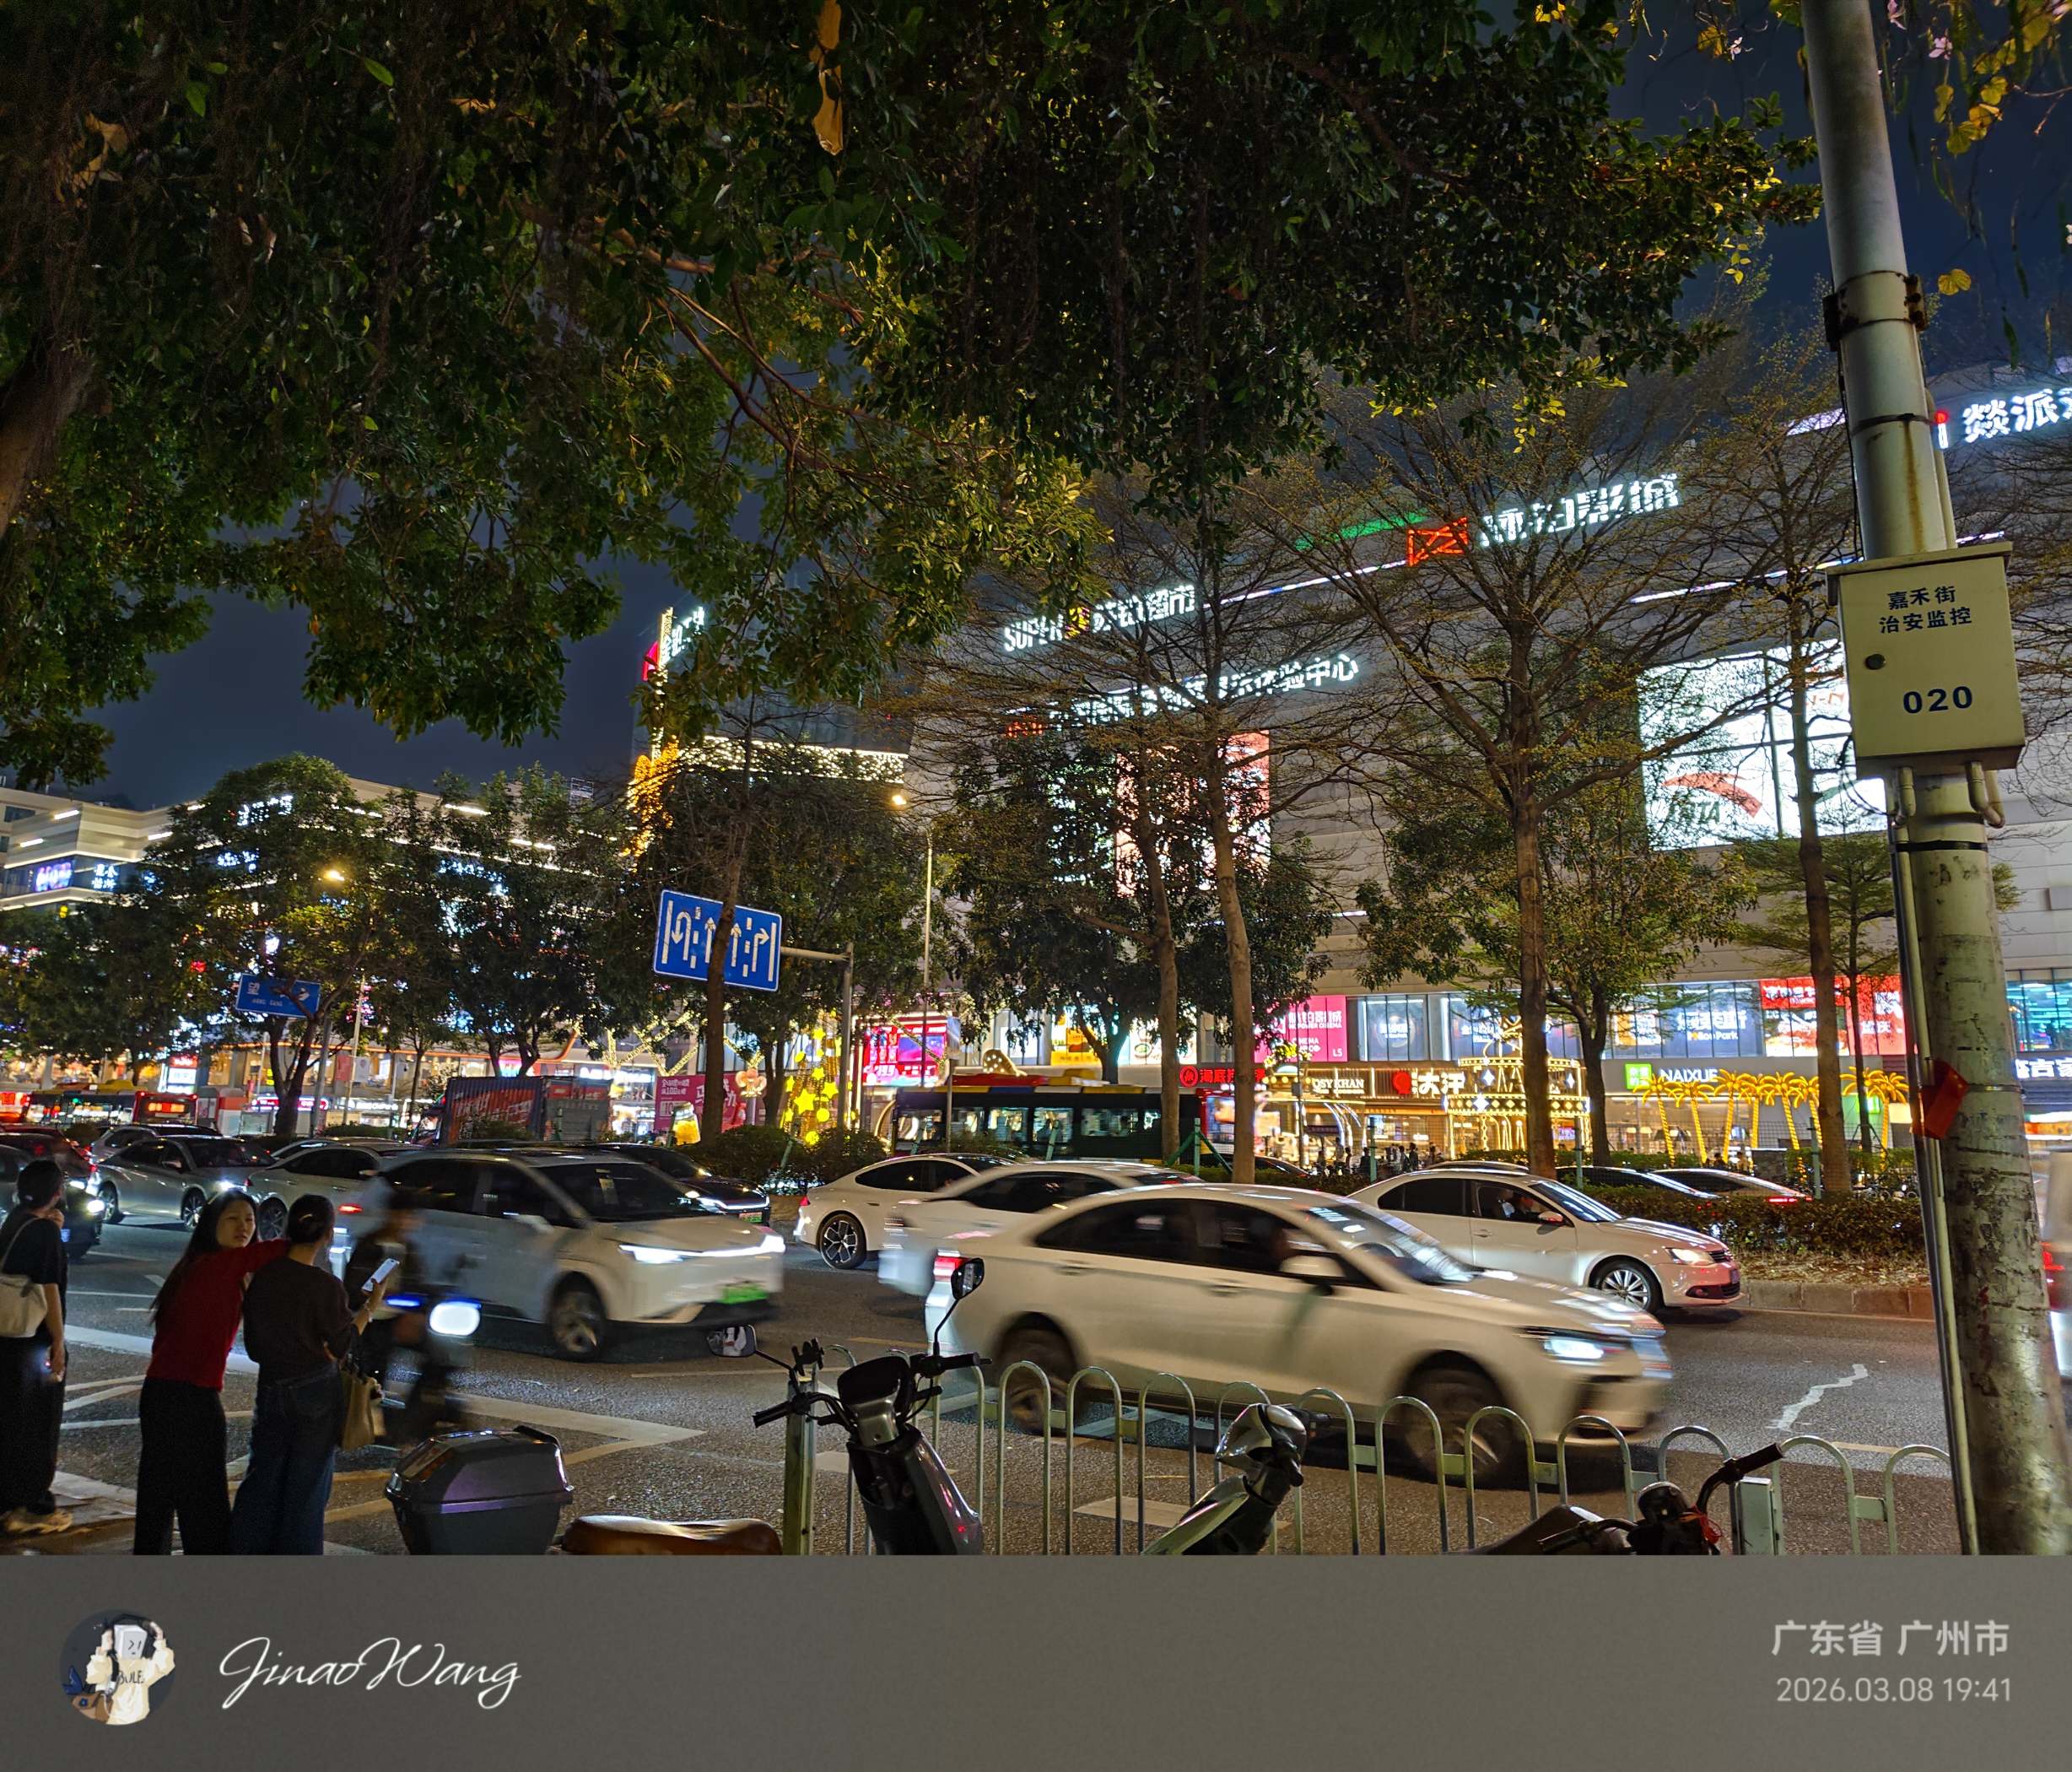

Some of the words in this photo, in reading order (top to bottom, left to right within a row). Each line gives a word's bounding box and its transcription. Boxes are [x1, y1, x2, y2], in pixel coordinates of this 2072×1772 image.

[1887, 586, 1956, 610] 嘉禾街
[1880, 607, 1972, 634] 治安监控
[1903, 686, 1972, 714] 020
[1334, 1078, 1364, 1089] KHAN
[1659, 1067, 1719, 1083] NAIXUE
